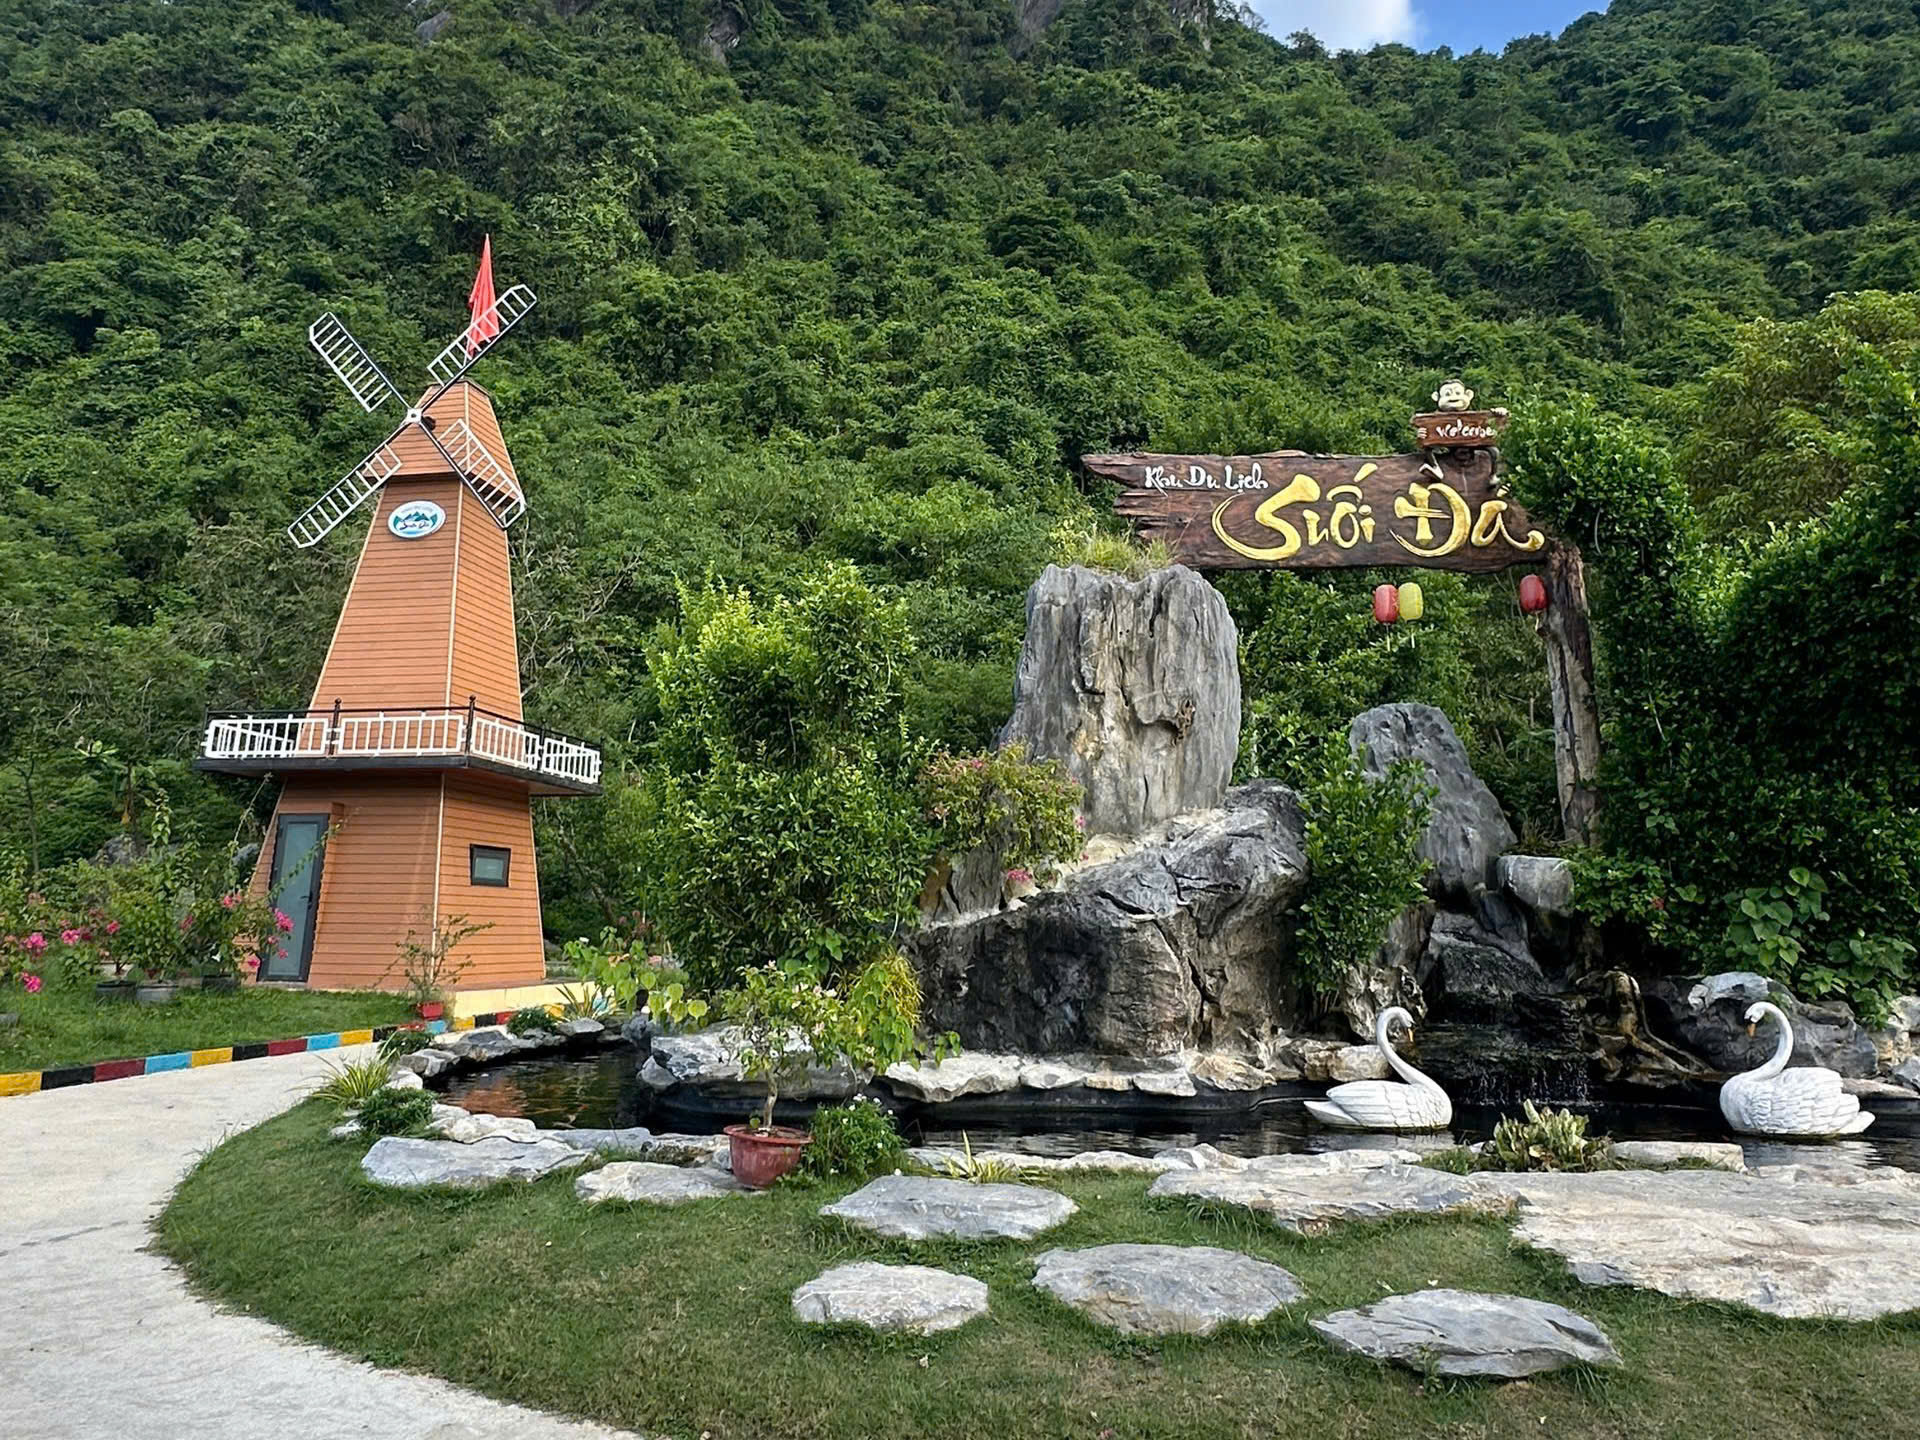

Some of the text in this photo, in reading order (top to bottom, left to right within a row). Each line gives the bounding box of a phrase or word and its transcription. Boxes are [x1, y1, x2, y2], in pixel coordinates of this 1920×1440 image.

[1145, 463, 1268, 490] Khu Du Lịch
[1211, 463, 1546, 561] Suối Đá
